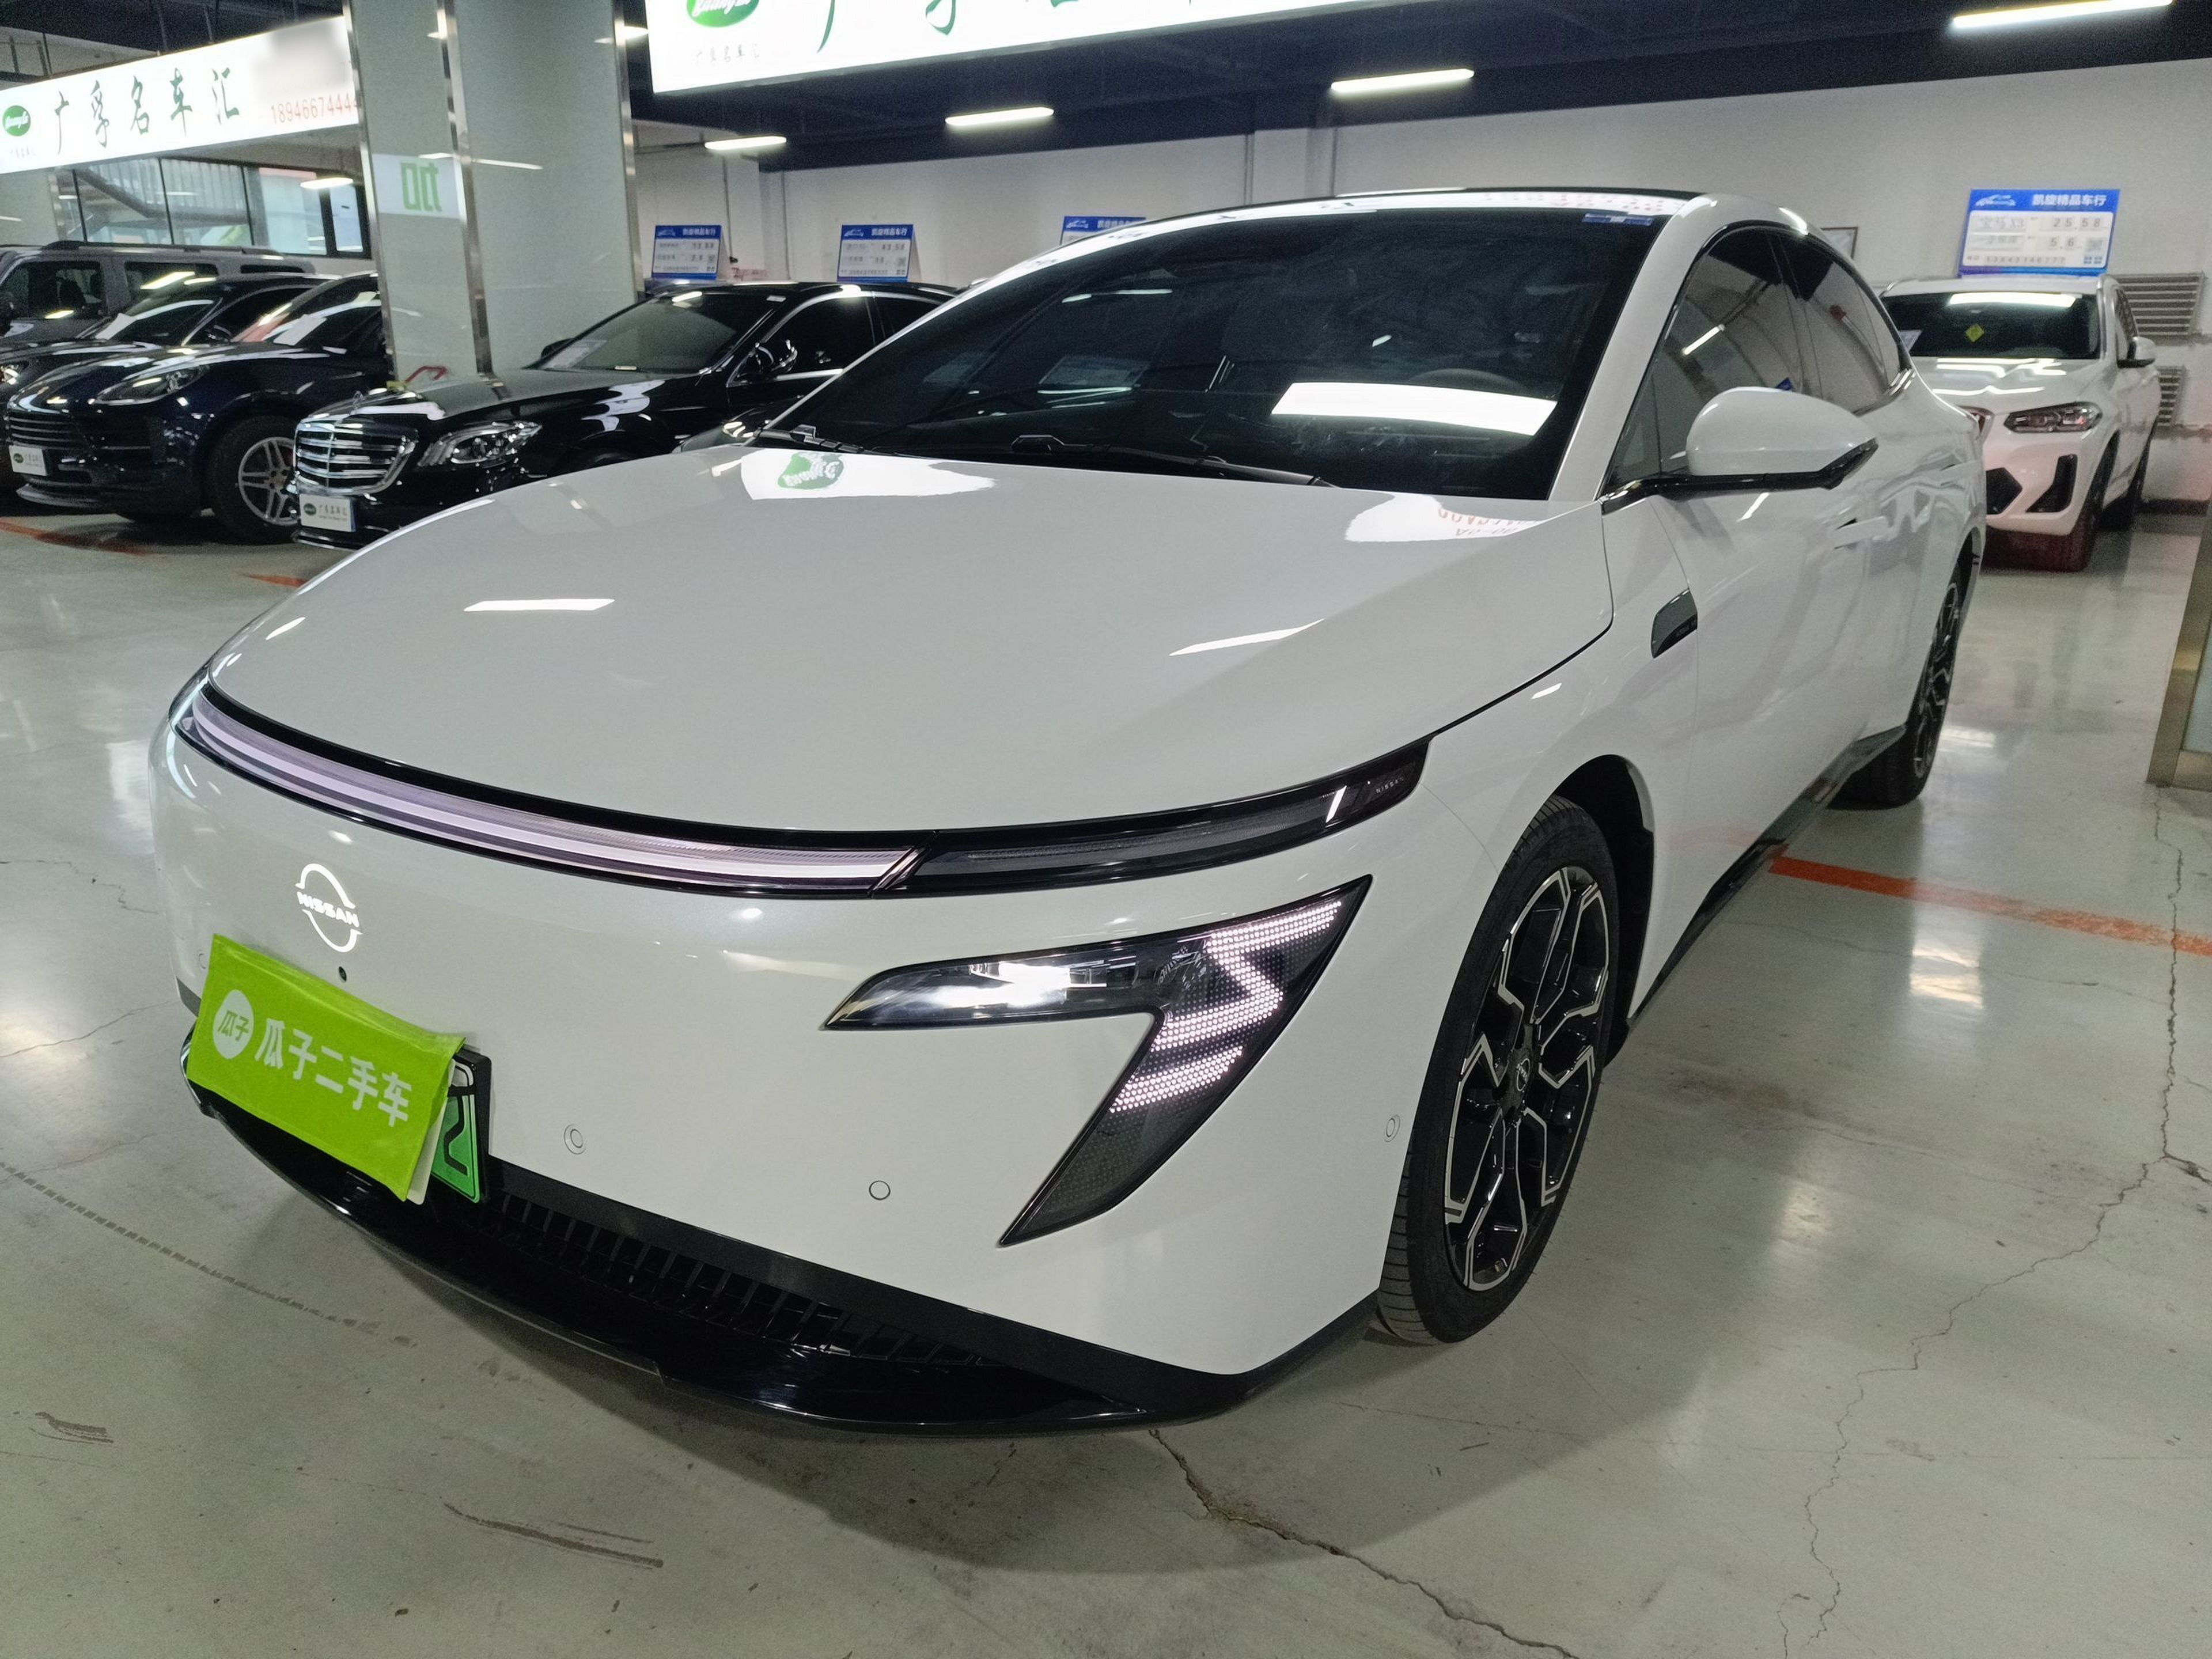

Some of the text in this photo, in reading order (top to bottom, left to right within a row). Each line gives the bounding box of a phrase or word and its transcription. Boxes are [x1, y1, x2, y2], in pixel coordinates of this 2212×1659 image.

[297, 891, 359, 927] NISSAN
[217, 1010, 249, 1041] 瓜子
[255, 1017, 412, 1127] 瓜子二手车
